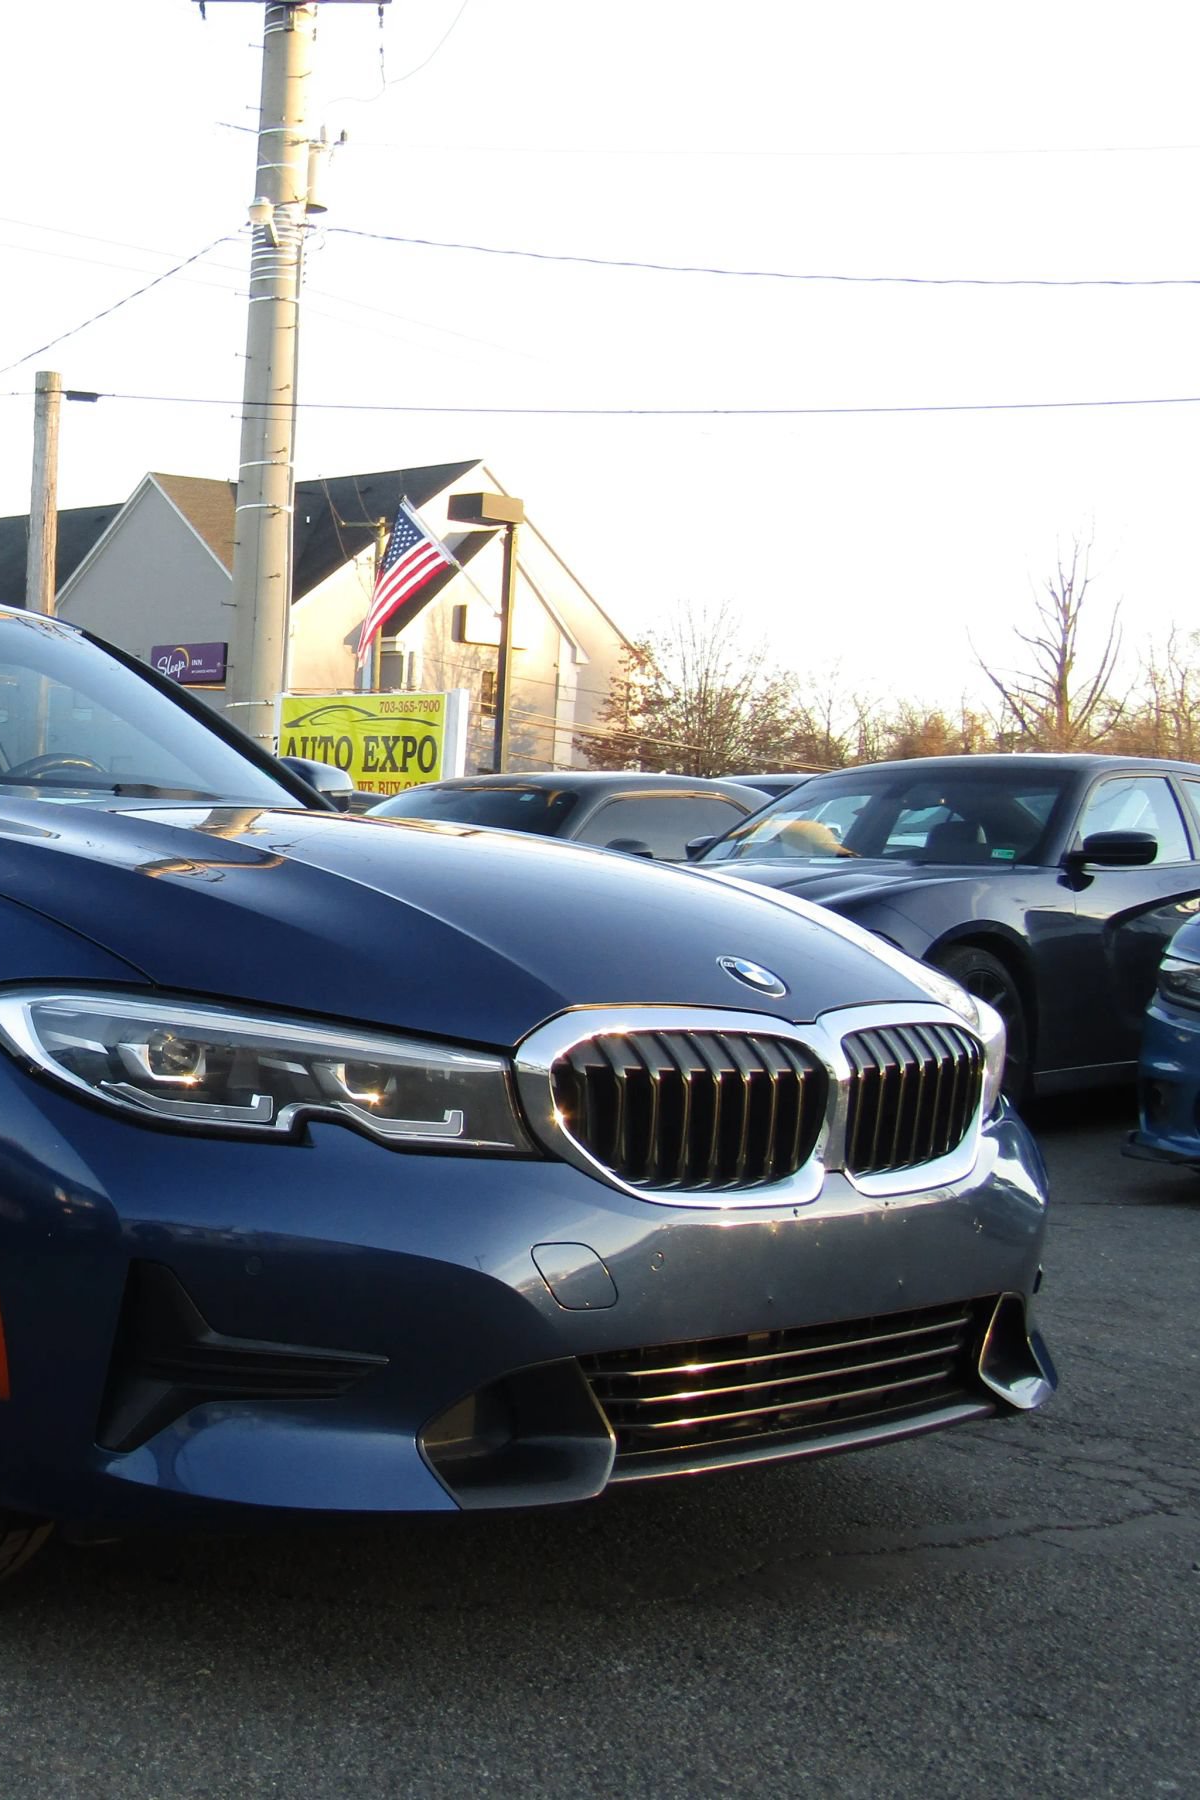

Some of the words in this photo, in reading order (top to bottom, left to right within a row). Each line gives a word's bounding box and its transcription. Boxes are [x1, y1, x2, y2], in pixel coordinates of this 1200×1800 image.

[157, 655, 186, 678] Sleep
[379, 700, 440, 713] 703-365-7900
[286, 735, 353, 772] AUTO
[362, 735, 438, 773] EXPO
[378, 781, 401, 796] BUY
